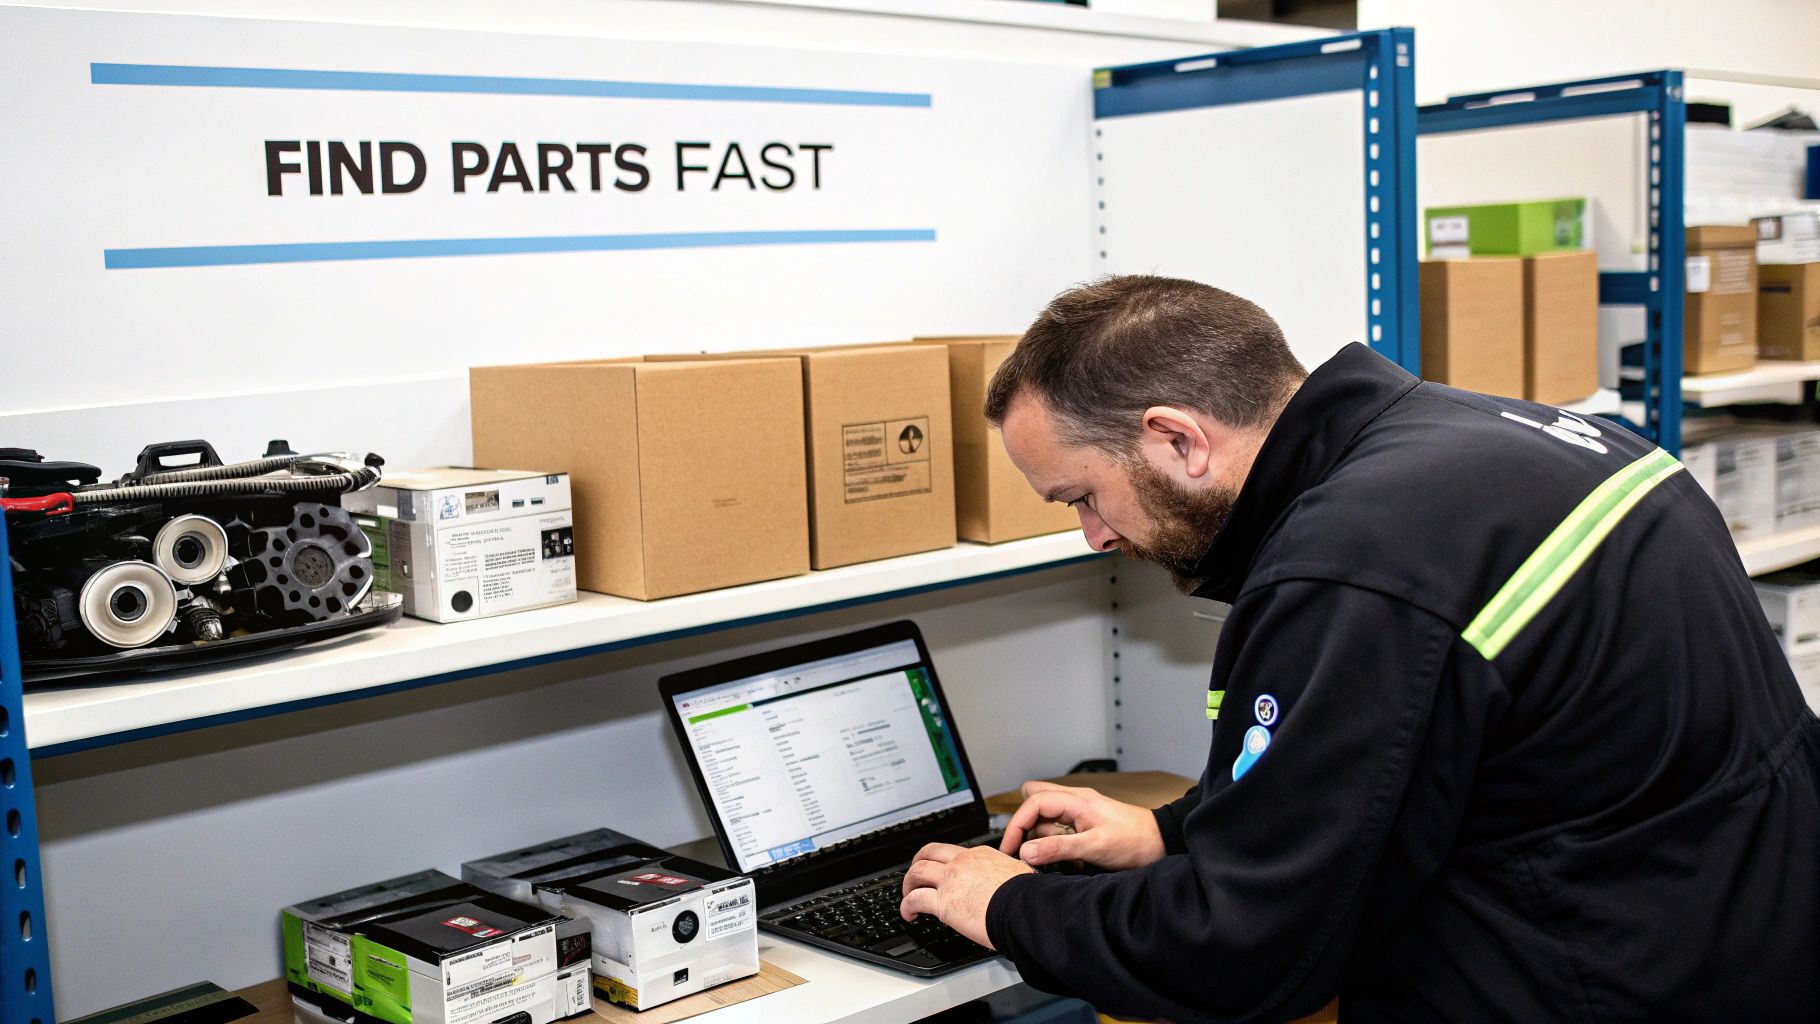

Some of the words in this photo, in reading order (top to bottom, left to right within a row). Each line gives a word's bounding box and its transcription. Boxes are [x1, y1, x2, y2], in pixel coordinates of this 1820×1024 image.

[264, 140, 427, 196] FIND
[451, 142, 650, 193] PARTS
[675, 143, 834, 191] FAST
